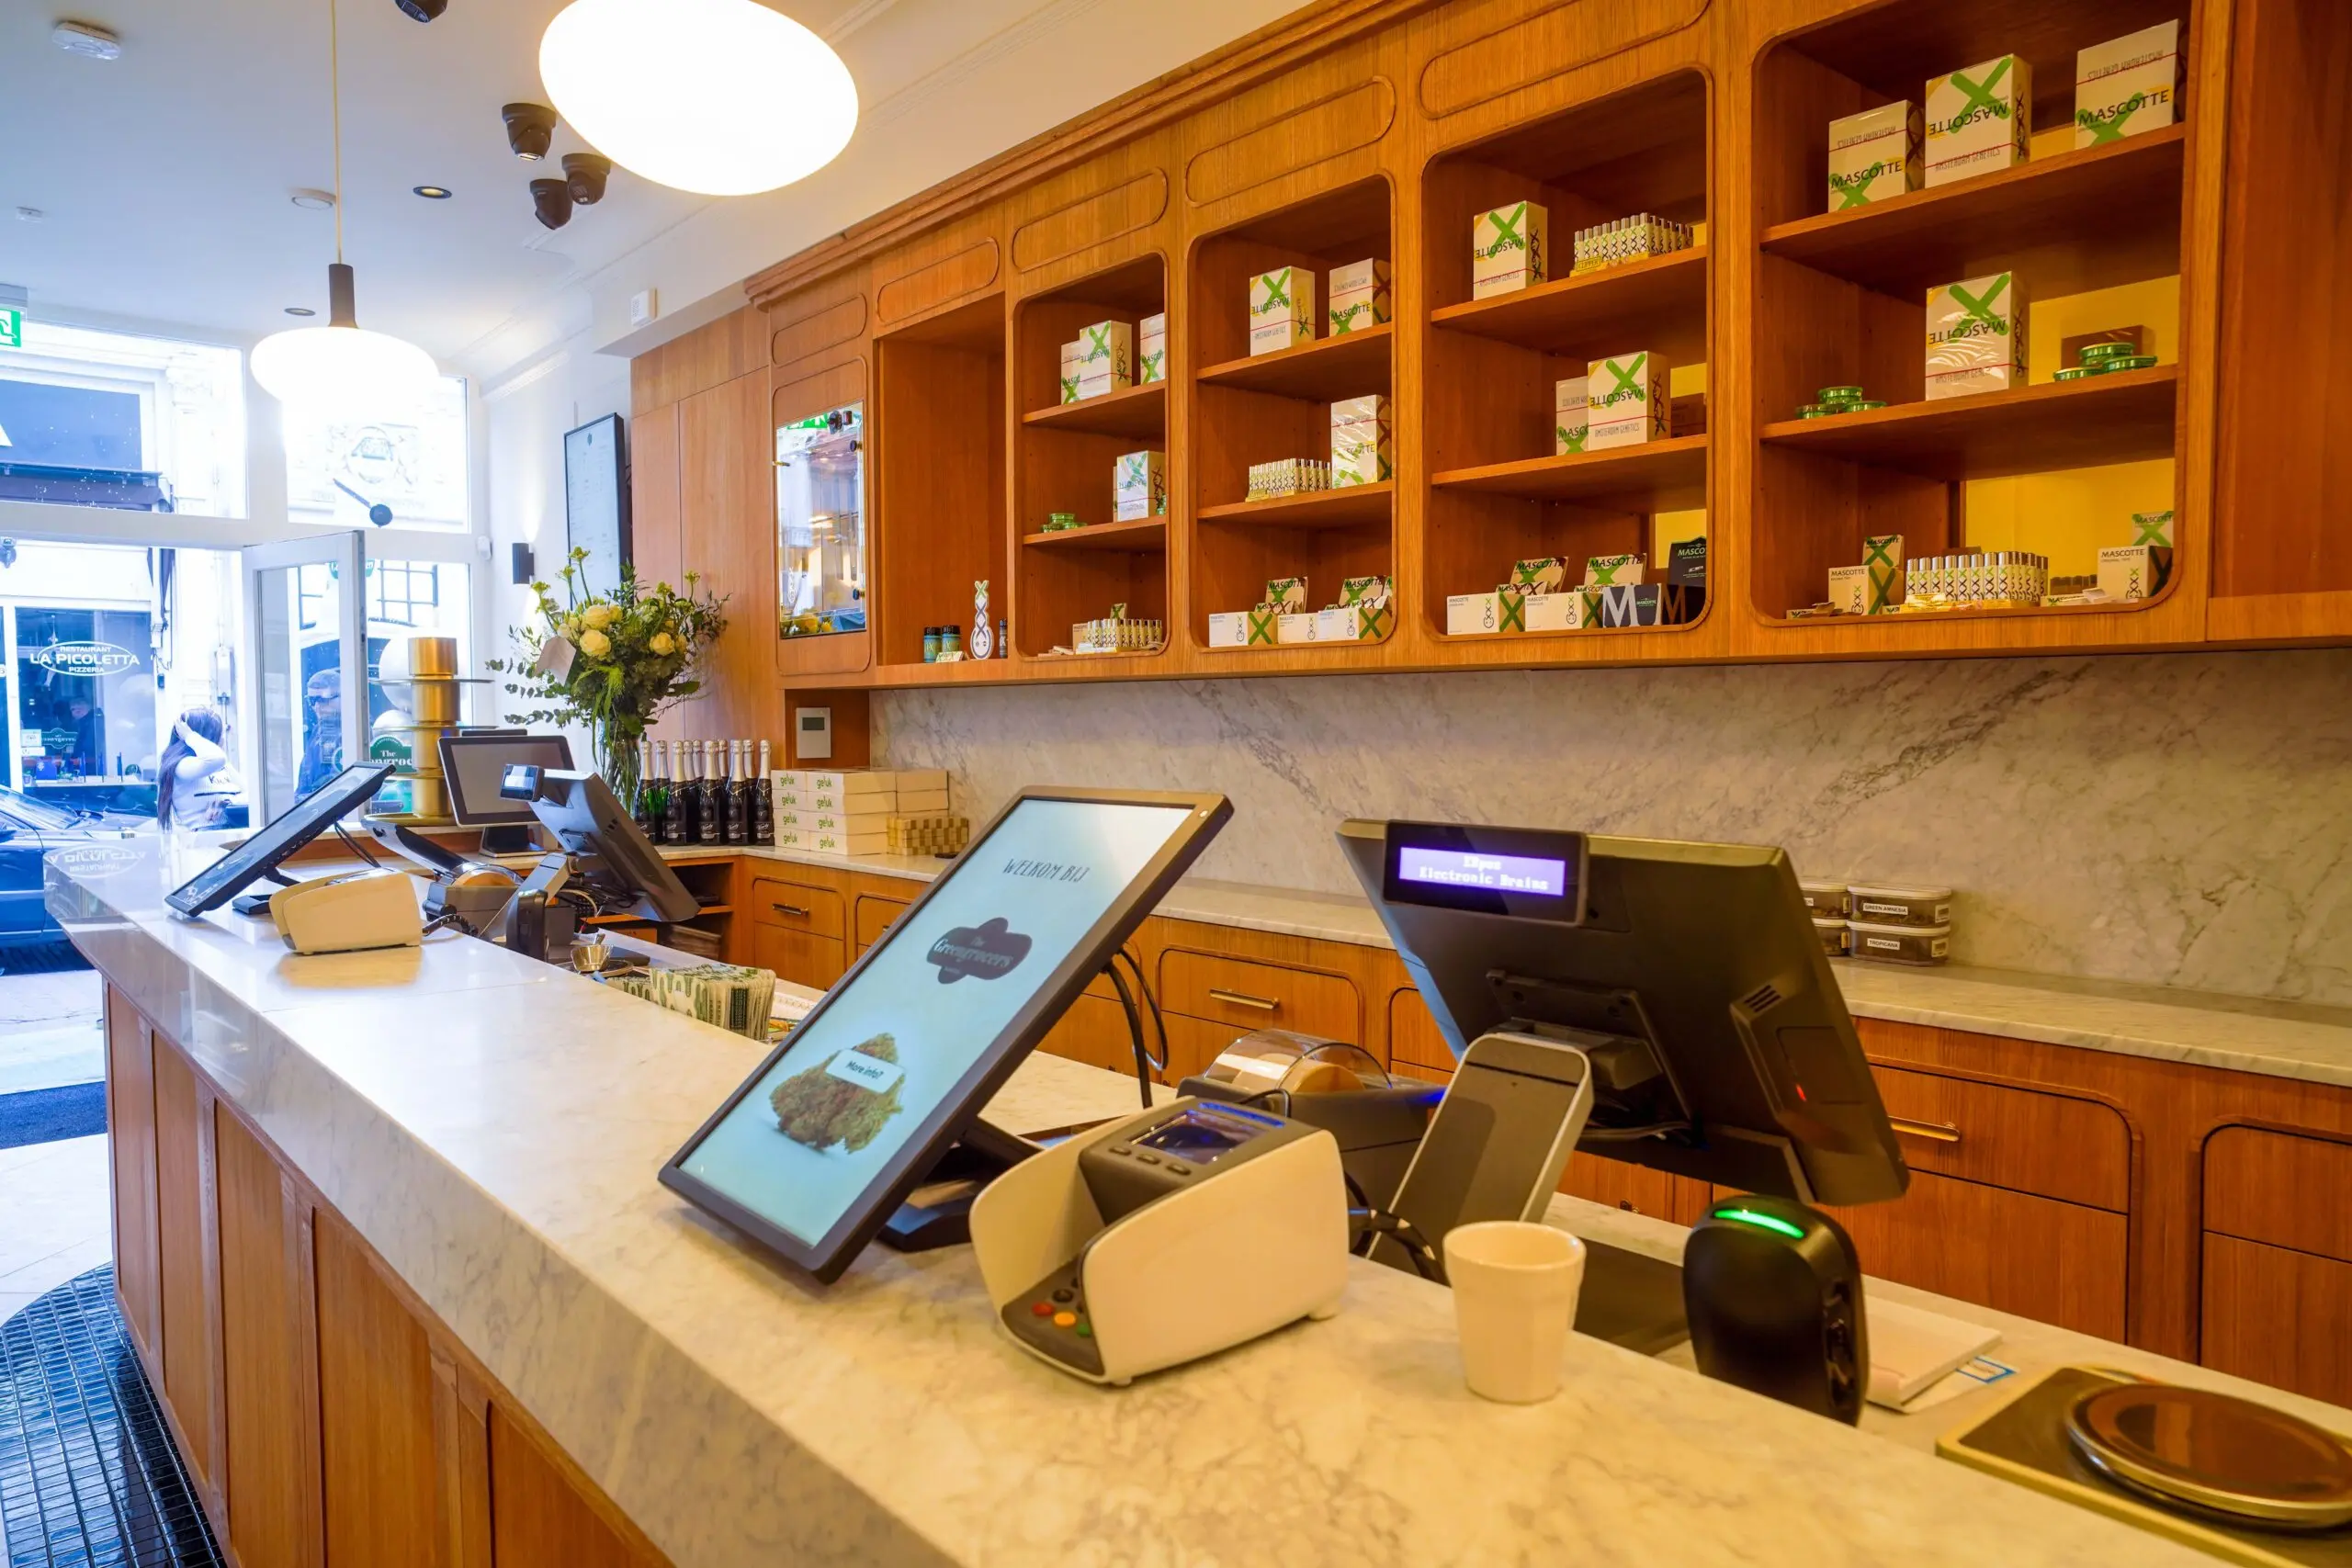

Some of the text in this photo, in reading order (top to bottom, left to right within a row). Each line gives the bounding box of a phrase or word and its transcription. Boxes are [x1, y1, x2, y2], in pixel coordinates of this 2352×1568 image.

[2077, 89, 2169, 126] MASCOTTE
[1929, 102, 2007, 136] MASCOTTE
[1831, 161, 1903, 188] MASCOTTE
[1475, 238, 1523, 258] MASCOTTE
[1251, 296, 1290, 315] MASCOTTE
[1330, 302, 1371, 321] MASCOTTE
[1928, 320, 2006, 344] MASCOTTE
[1590, 388, 1645, 406] MASCOTTE
[2101, 548, 2144, 558] MASCOTTE
[29, 653, 140, 665] LA PICOLETTA
[380, 750, 396, 758] The
[817, 775, 832, 789] geluk
[782, 792, 797, 806] geluk
[817, 795, 832, 808] geluk
[783, 812, 797, 825] geluk
[820, 835, 835, 849] geluk
[1002, 859, 1091, 883] WELKOM BIJ
[1419, 866, 1548, 890] Electronic Brains
[1883, 906, 1906, 914] AMNESIA
[933, 938, 1013, 968] Greengrocers
[1869, 940, 1899, 948] TROPICANA
